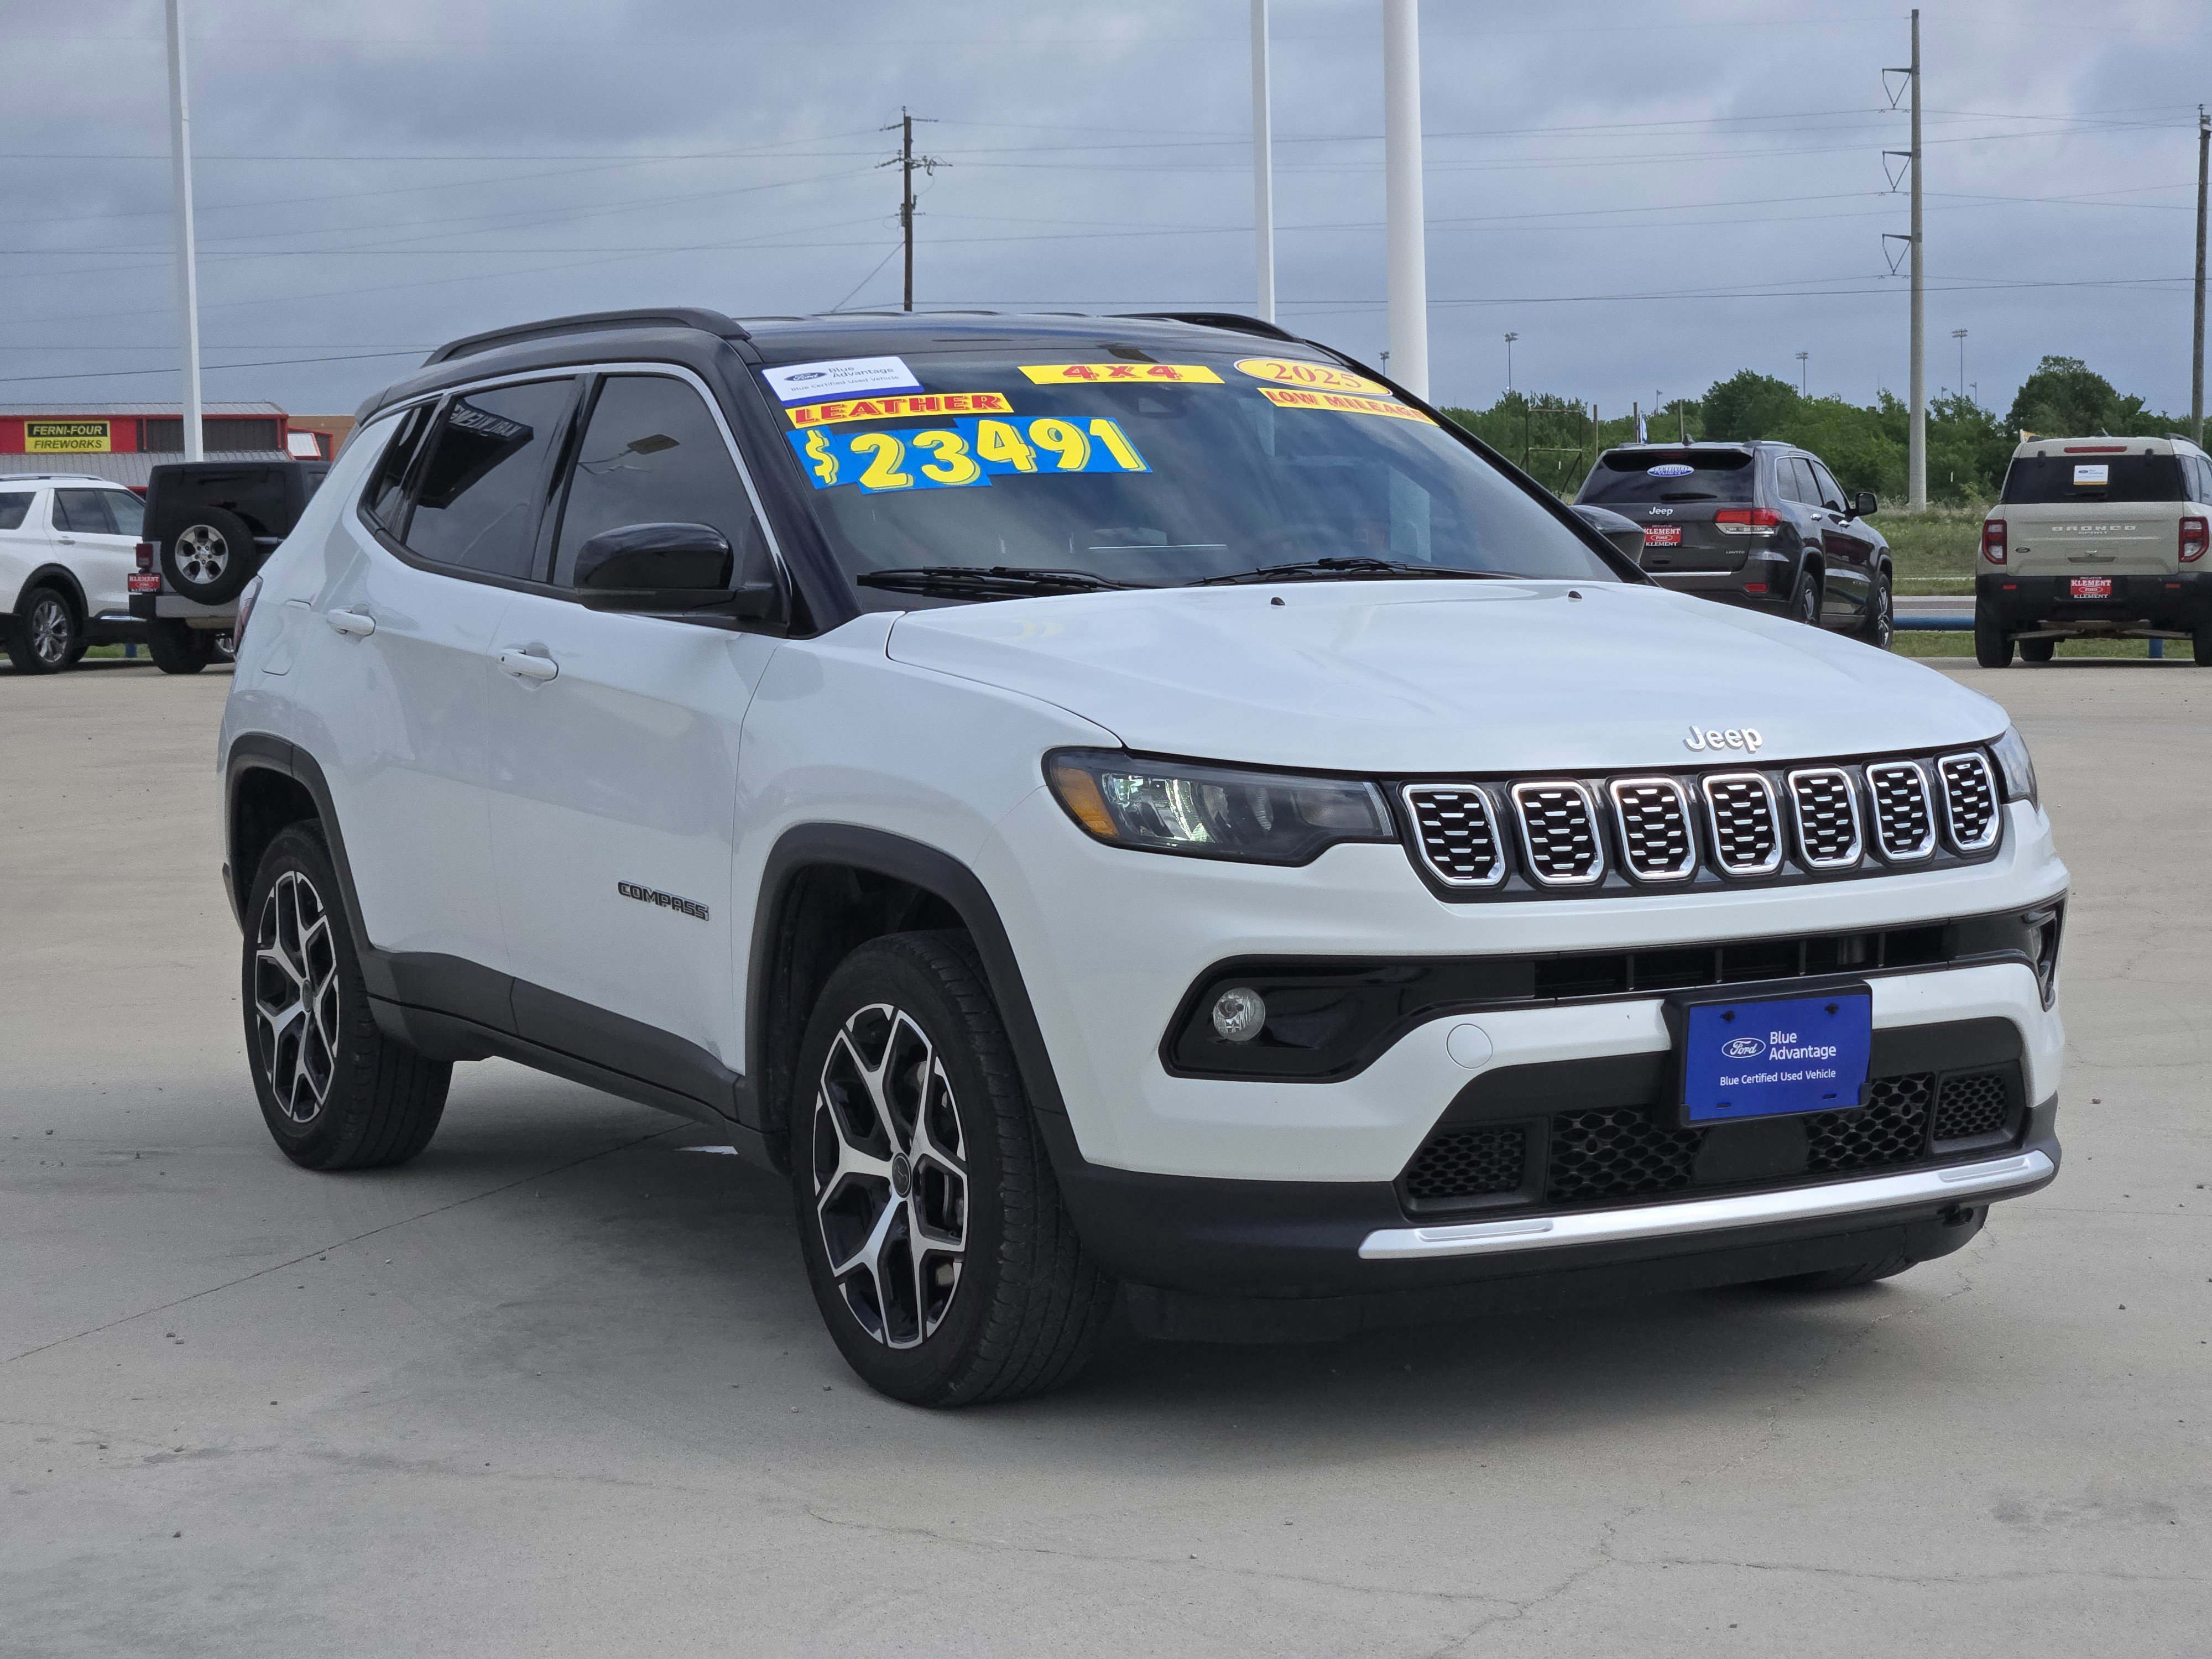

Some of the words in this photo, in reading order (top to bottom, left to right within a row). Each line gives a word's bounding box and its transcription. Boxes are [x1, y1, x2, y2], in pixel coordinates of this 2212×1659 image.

[833, 368, 894, 378] Advantage
[1266, 363, 1361, 388] 2025
[795, 395, 1002, 425] LEATHER
[1264, 390, 1318, 405] LOW
[1323, 395, 1428, 421] MILEAGE
[33, 426, 103, 435] FERNI-FOUR
[34, 440, 102, 449] FIREWORKS
[805, 418, 1147, 489] $23491
[1648, 507, 1673, 517] Jeep
[1683, 725, 1763, 754] Jeep
[618, 880, 709, 921] COMPASS
[1770, 1030, 1797, 1045] Blue
[1768, 1045, 1837, 1061] Advantage
[1720, 1076, 1739, 1086] Blue
[1741, 1072, 1778, 1084] Certified
[1780, 1071, 1803, 1081] Used
[1806, 1068, 1836, 1079] Vehicle
